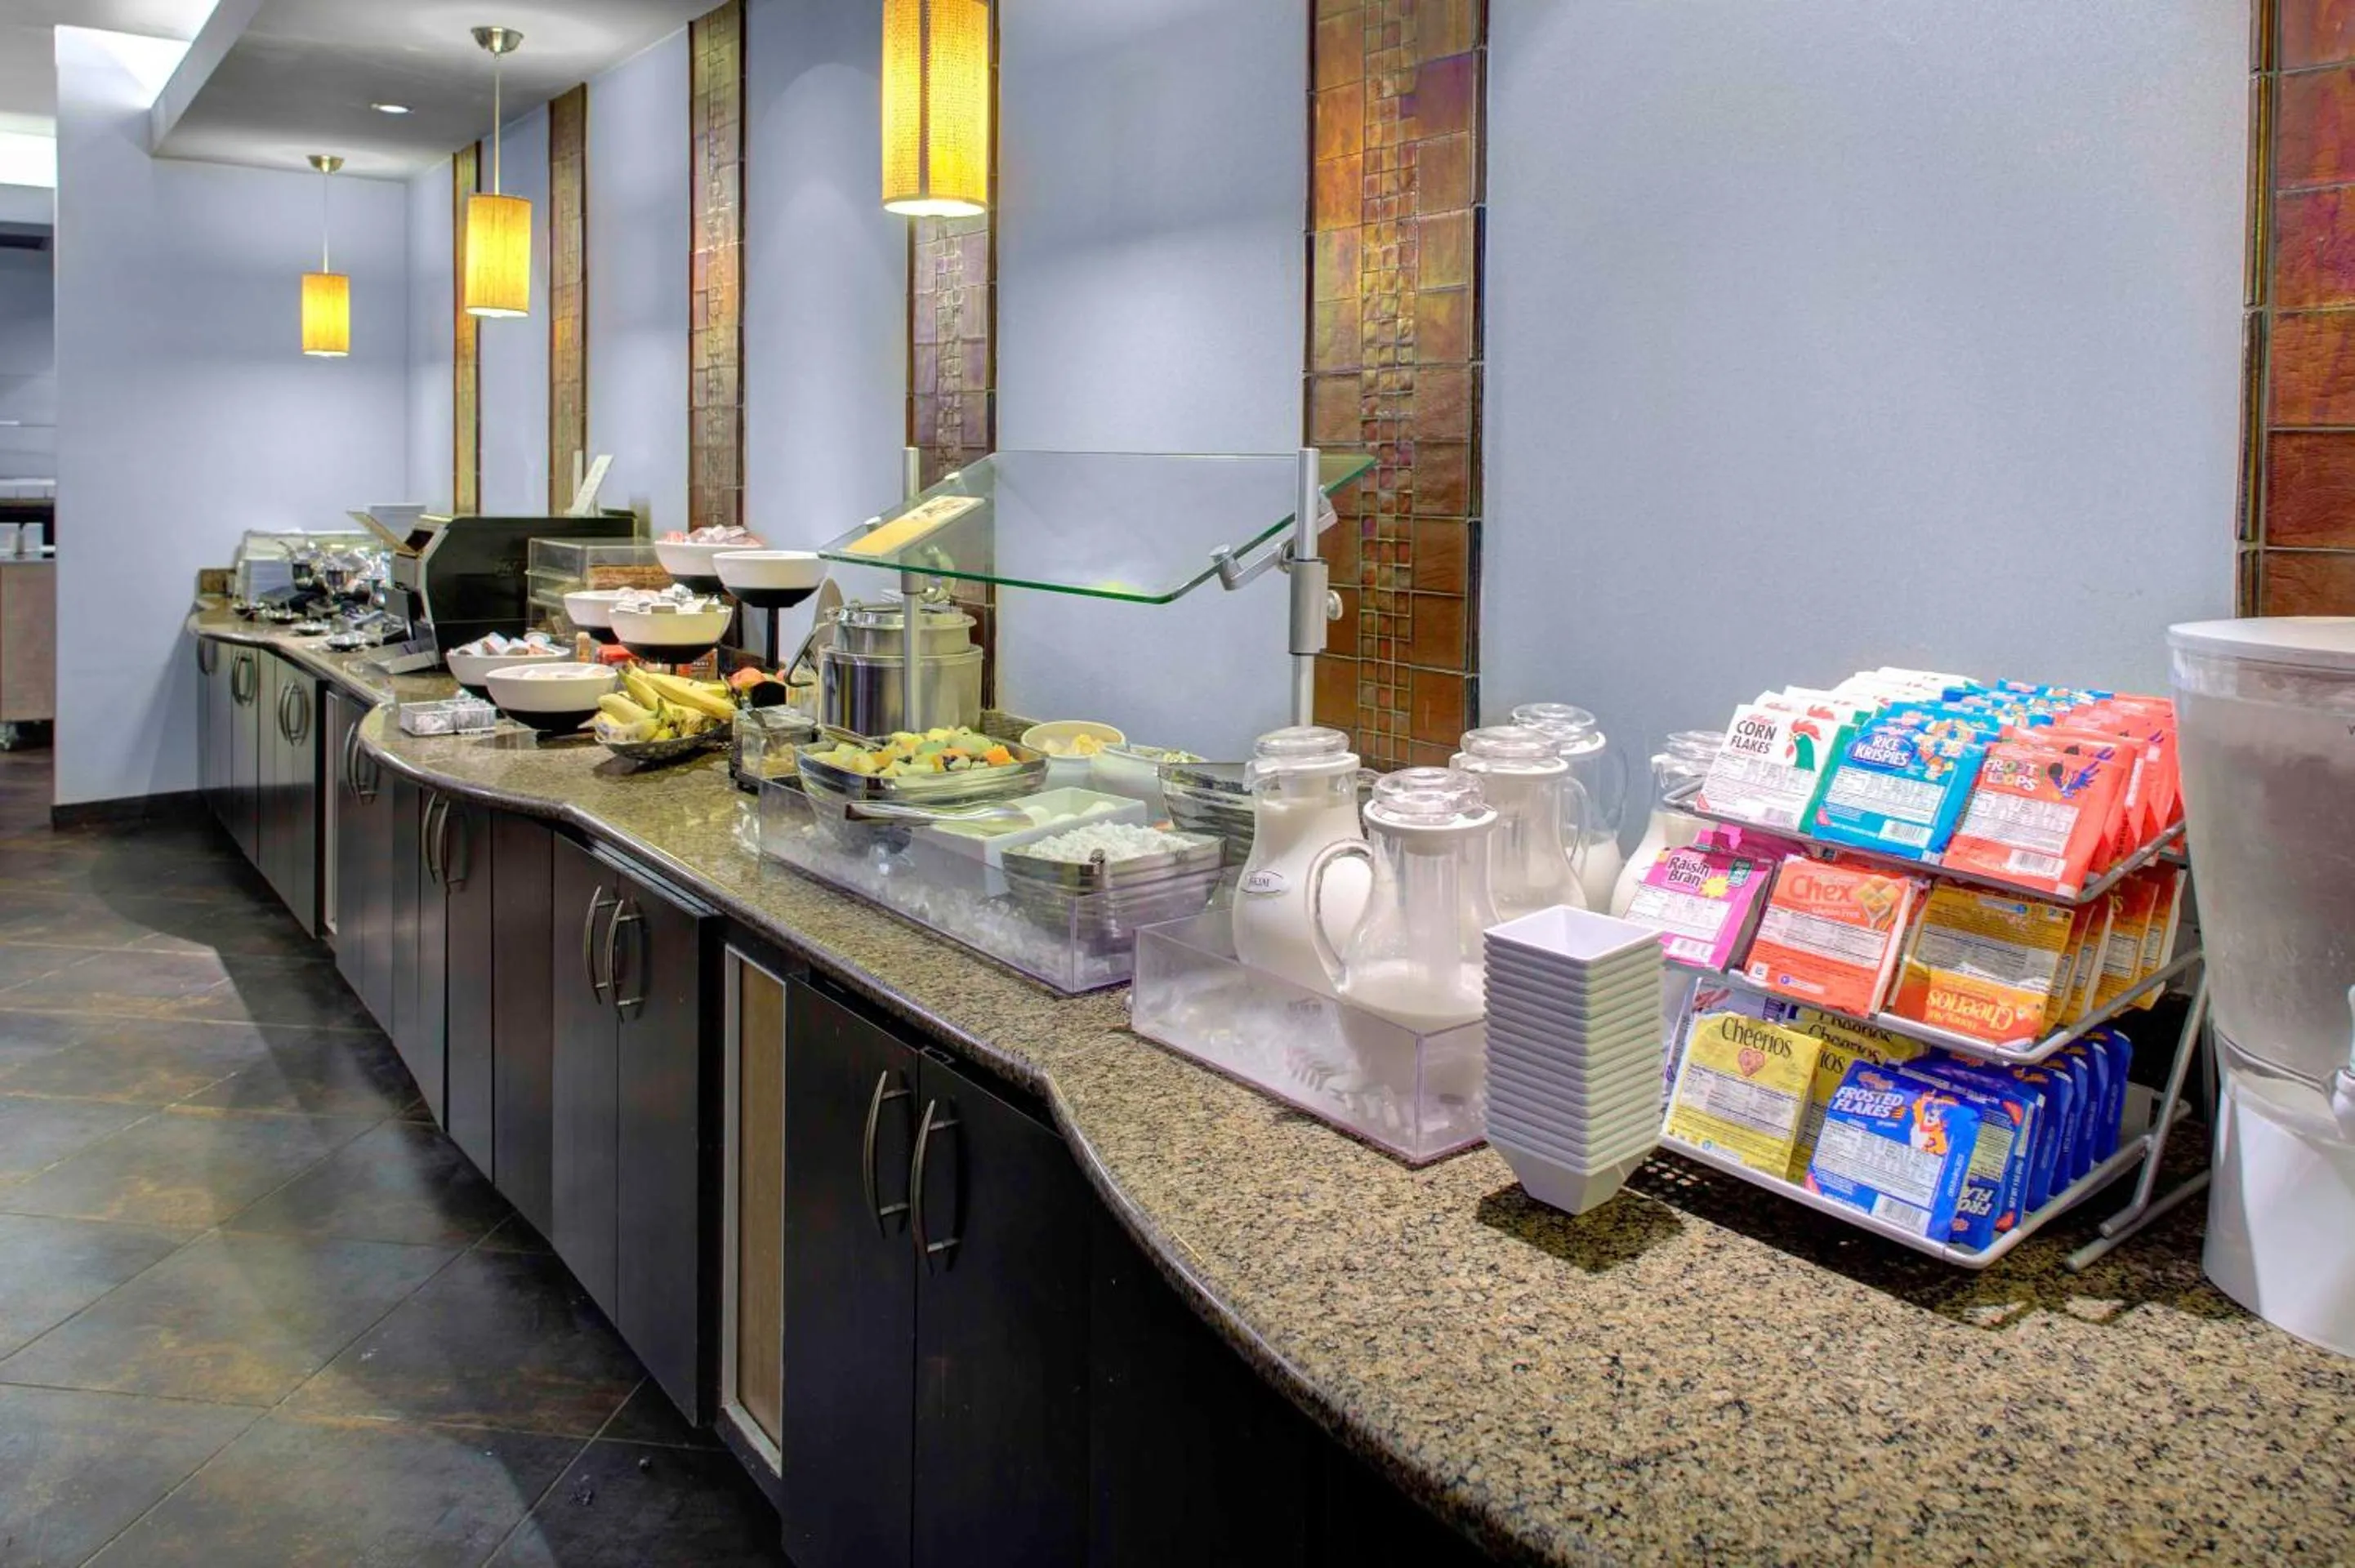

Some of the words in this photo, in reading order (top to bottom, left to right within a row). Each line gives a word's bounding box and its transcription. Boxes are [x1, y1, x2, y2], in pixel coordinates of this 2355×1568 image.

[1736, 719, 1777, 741] CORN
[1729, 735, 1772, 754] FLAKES
[1871, 734, 1900, 751] RICE
[1853, 744, 1911, 767] KRISPIES
[1983, 758, 2039, 776] FROOT
[1667, 856, 1710, 877] Raisin
[1667, 869, 1702, 887] Bran
[1789, 874, 1853, 902] Chex
[1928, 989, 2014, 1031] Cheerios
[1721, 1016, 1794, 1059] Cheerios
[1835, 1086, 1904, 1107] FROSTED
[1832, 1098, 1893, 1119] FLAKES
